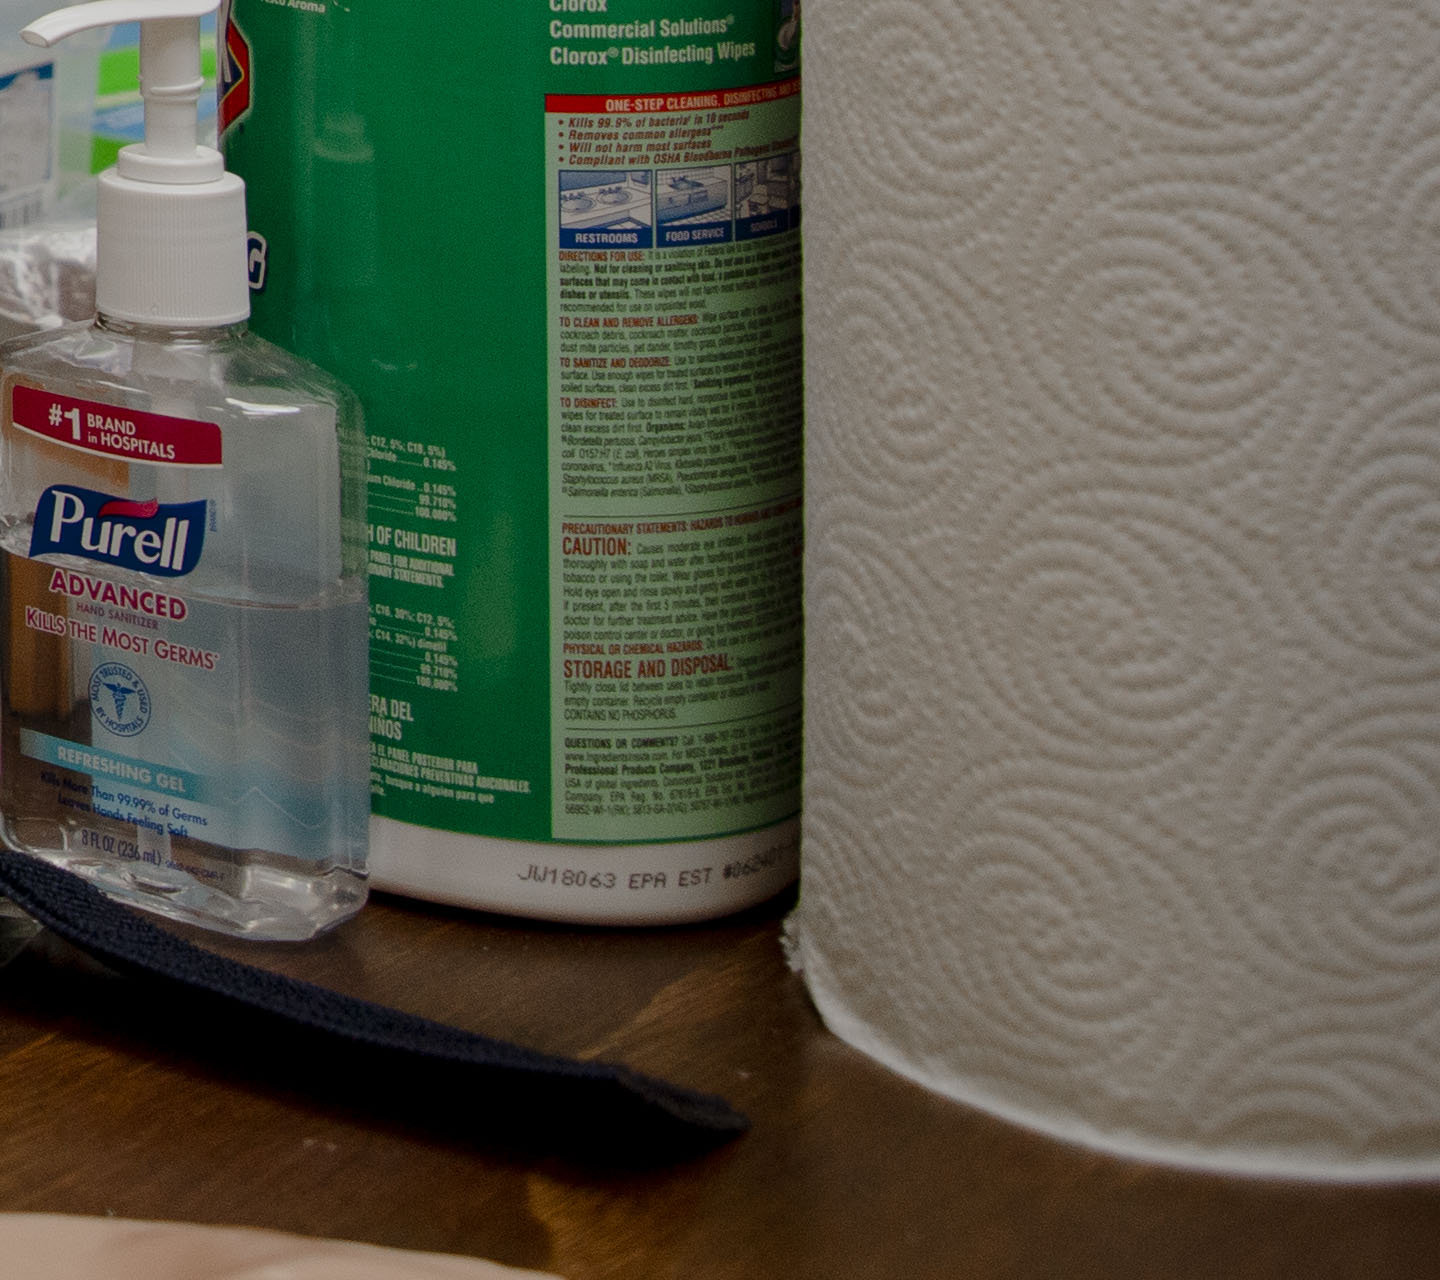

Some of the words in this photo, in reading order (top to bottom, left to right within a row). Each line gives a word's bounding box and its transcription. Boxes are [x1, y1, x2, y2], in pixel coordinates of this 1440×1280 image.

[549, 19, 655, 39] Commercial
[622, 44, 713, 65] Disinfecting
[717, 41, 756, 61] Wipes
[605, 97, 664, 112] ONE-STEP
[569, 117, 594, 129] Kills
[597, 116, 631, 128] 99.9%
[636, 116, 646, 128] of
[569, 129, 619, 141] Removes
[622, 129, 667, 140] common
[569, 142, 593, 154] Will
[595, 142, 611, 153] not
[616, 141, 642, 153] harm
[646, 141, 670, 152] most
[672, 139, 712, 151] surfaces
[569, 154, 626, 167] Compliant
[628, 153, 650, 165] with
[653, 151, 681, 164] OSHA
[575, 233, 638, 244] RESTROOMS
[665, 230, 690, 241] FOOD
[691, 227, 725, 240] SERVICE
[559, 251, 608, 262] DIRECTIONS
[610, 251, 626, 262] FOR
[559, 317, 571, 328] TO
[573, 317, 600, 328] CLEAN
[602, 317, 619, 328] AND
[621, 316, 654, 328] REMOVE
[560, 357, 571, 368] TO
[573, 357, 608, 368] SANITIZE
[610, 357, 627, 368] AND
[560, 397, 572, 408] TO
[48, 402, 81, 441] #1
[87, 413, 136, 435] BRAND
[88, 432, 98, 444] in
[101, 434, 175, 460] HOSPITALS
[50, 490, 190, 571] Purell
[562, 523, 634, 535] PRECAUTIONARY
[376, 525, 392, 546] OF
[394, 528, 457, 557] CHILDREN
[562, 536, 631, 556] CAUTION:
[51, 570, 187, 620] ADVANCED
[77, 603, 105, 617] HAND
[108, 609, 159, 630] SANITIZER
[26, 607, 65, 635] KILLS
[69, 621, 97, 642] THE
[102, 627, 149, 655] MOST
[563, 643, 605, 655] PHYSICAL
[608, 643, 621, 654] OR
[623, 643, 664, 655] CHEMICAL
[563, 659, 632, 679] STORAGE
[637, 658, 666, 678] AND
[90, 674, 103, 702] MOST
[100, 665, 131, 681] TRUSTED
[132, 677, 139, 687] &
[138, 689, 148, 714] USED
[96, 706, 106, 718] BY
[105, 716, 144, 734] HOSPITALS
[390, 699, 414, 722] DEL
[564, 709, 607, 721] CONTAINS
[608, 709, 620, 721] NO
[565, 738, 611, 749] QUESTIONS
[57, 746, 152, 784] REFRESHING
[156, 772, 186, 792] GEL
[40, 771, 59, 787] Kills
[64, 779, 88, 794] More
[91, 785, 114, 802] Than
[117, 792, 156, 814] 99.99%
[158, 805, 169, 817] of
[172, 807, 208, 826] Germs
[58, 793, 90, 813] Leaves
[92, 803, 124, 822] Hands
[127, 812, 164, 835] Feeling
[167, 823, 189, 838] Soft
[81, 829, 88, 846] 8
[91, 832, 101, 849] FL
[102, 835, 115, 852] OZ
[117, 842, 141, 862] (236
[142, 850, 162, 867] mL)
[517, 864, 616, 889] JW18063
[629, 872, 667, 889] EPA
[678, 867, 713, 887] EST
